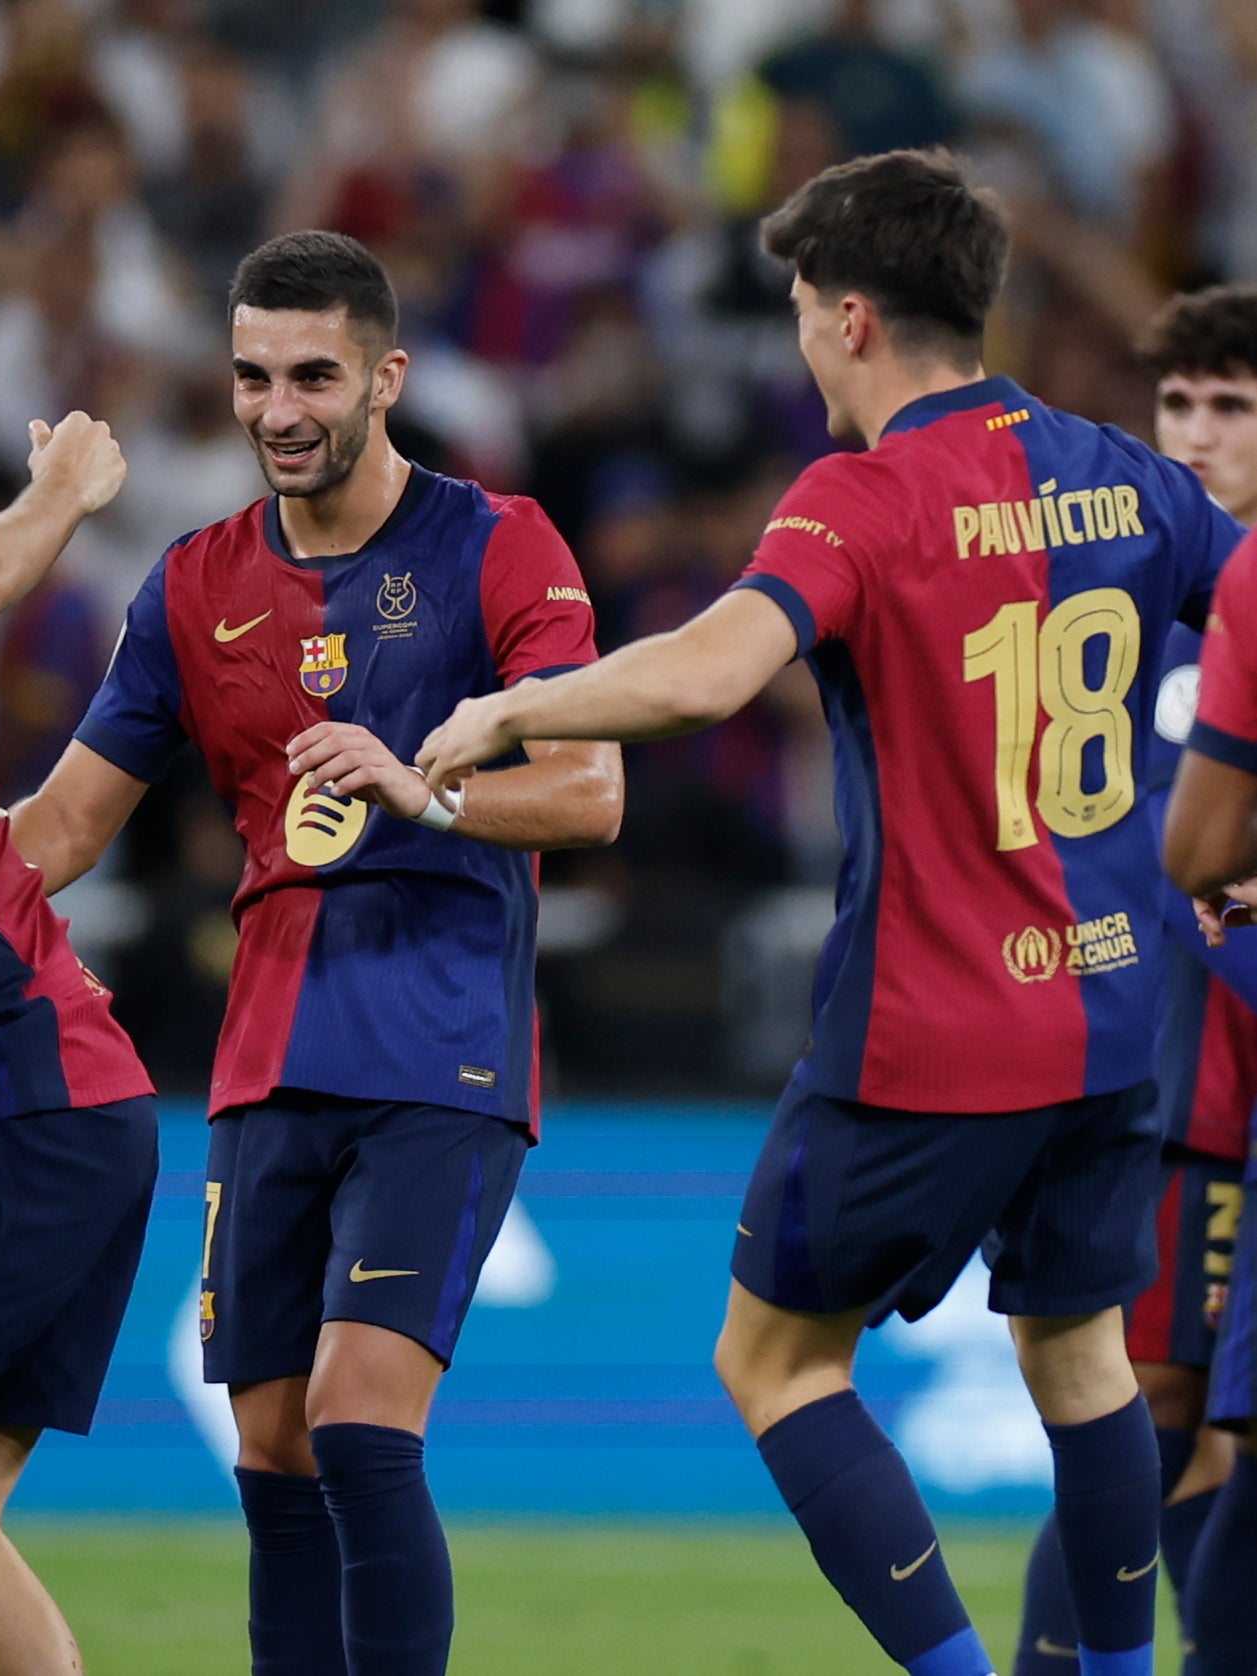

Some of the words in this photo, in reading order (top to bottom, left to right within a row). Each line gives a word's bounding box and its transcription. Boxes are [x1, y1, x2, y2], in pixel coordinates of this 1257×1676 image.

[963, 587, 1141, 851] 18
[1065, 911, 1131, 947] UNHCR
[1065, 933, 1137, 967] ACNUR
